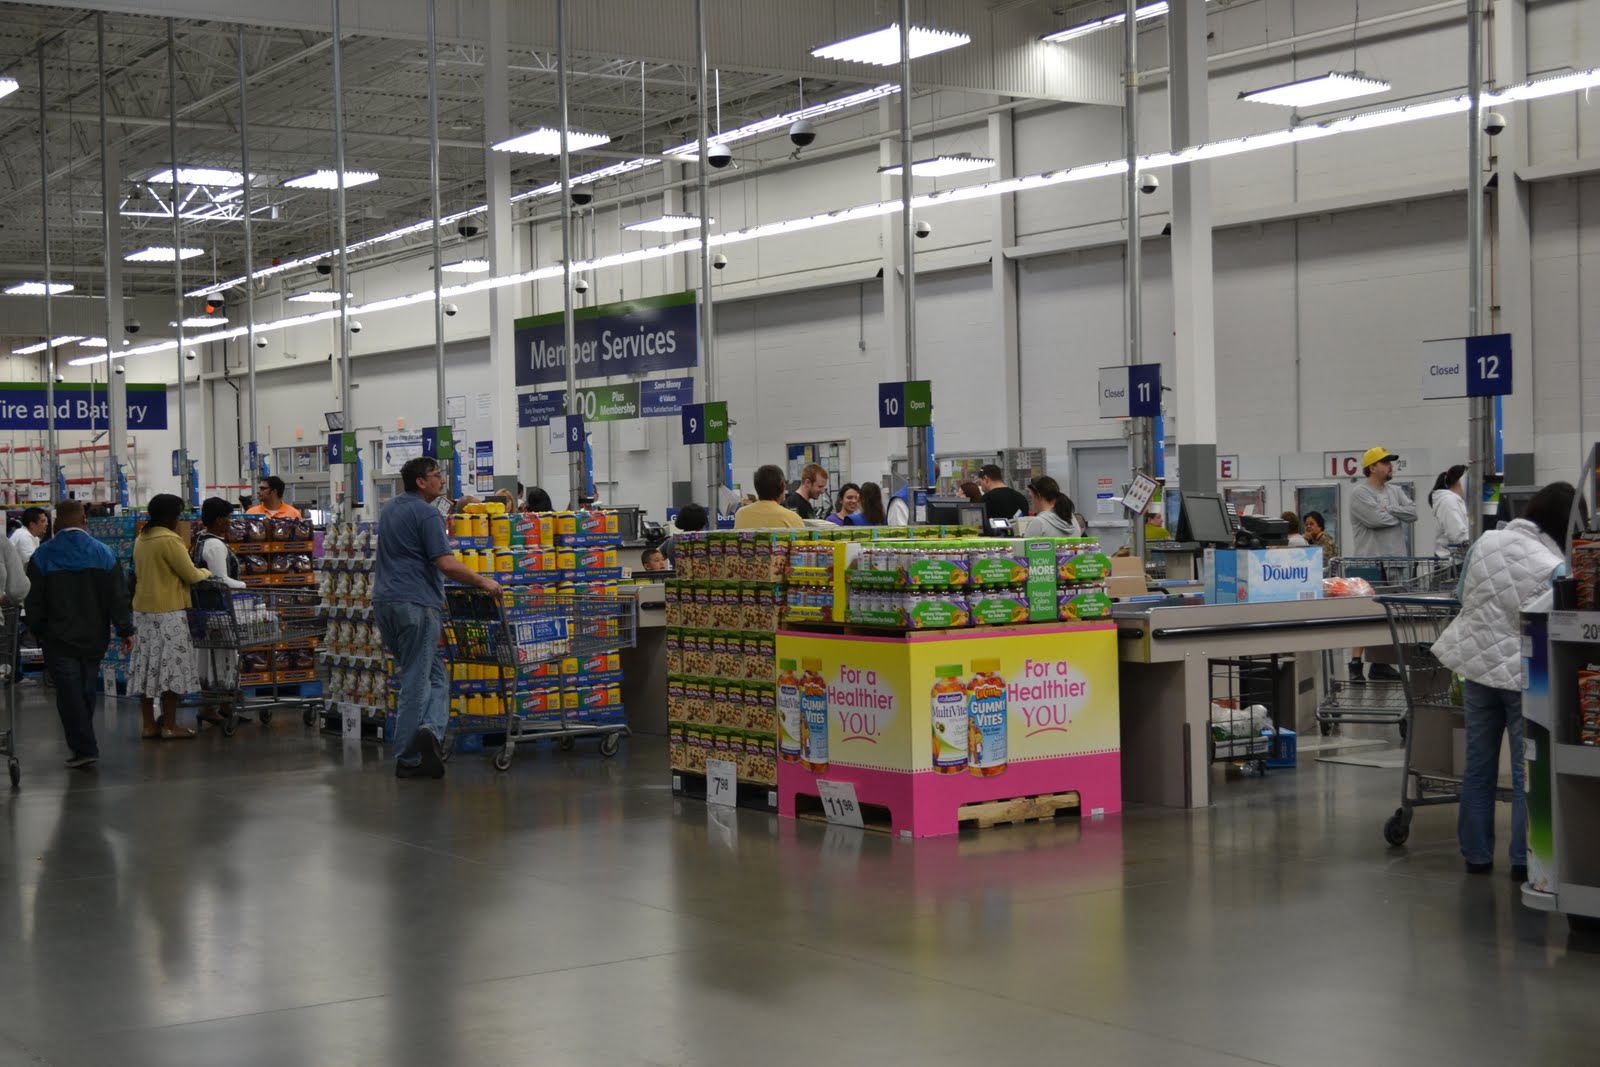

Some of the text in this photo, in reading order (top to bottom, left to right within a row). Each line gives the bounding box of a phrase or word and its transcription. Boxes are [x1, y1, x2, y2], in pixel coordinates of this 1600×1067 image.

[602, 325, 677, 361] Services
[1430, 364, 1460, 376] Closed
[1477, 355, 1500, 379] 12
[612, 391, 624, 402] Plus
[1104, 388, 1125, 398] Closed
[1138, 382, 1150, 402] 11
[0, 400, 27, 419] ire
[33, 400, 70, 418] and
[601, 403, 636, 416] Membership
[884, 398, 899, 416] 10
[910, 401, 926, 410] Open
[690, 418, 697, 433] 9
[710, 419, 722, 428] Open
[572, 427, 578, 442] 8
[332, 443, 338, 456] 6
[426, 438, 432, 451] 7
[440, 439, 450, 447] Open
[1029, 565, 1055, 576] MORE
[1262, 564, 1308, 582] Downy
[841, 664, 876, 685] For a
[1025, 659, 1067, 678] For a
[827, 686, 893, 710] Healthier
[1007, 679, 1086, 702] Healthier
[806, 711, 825, 724] VITES
[839, 711, 880, 736] YOU.
[977, 713, 1003, 726] VITES
[1022, 704, 1072, 728] YOU.
